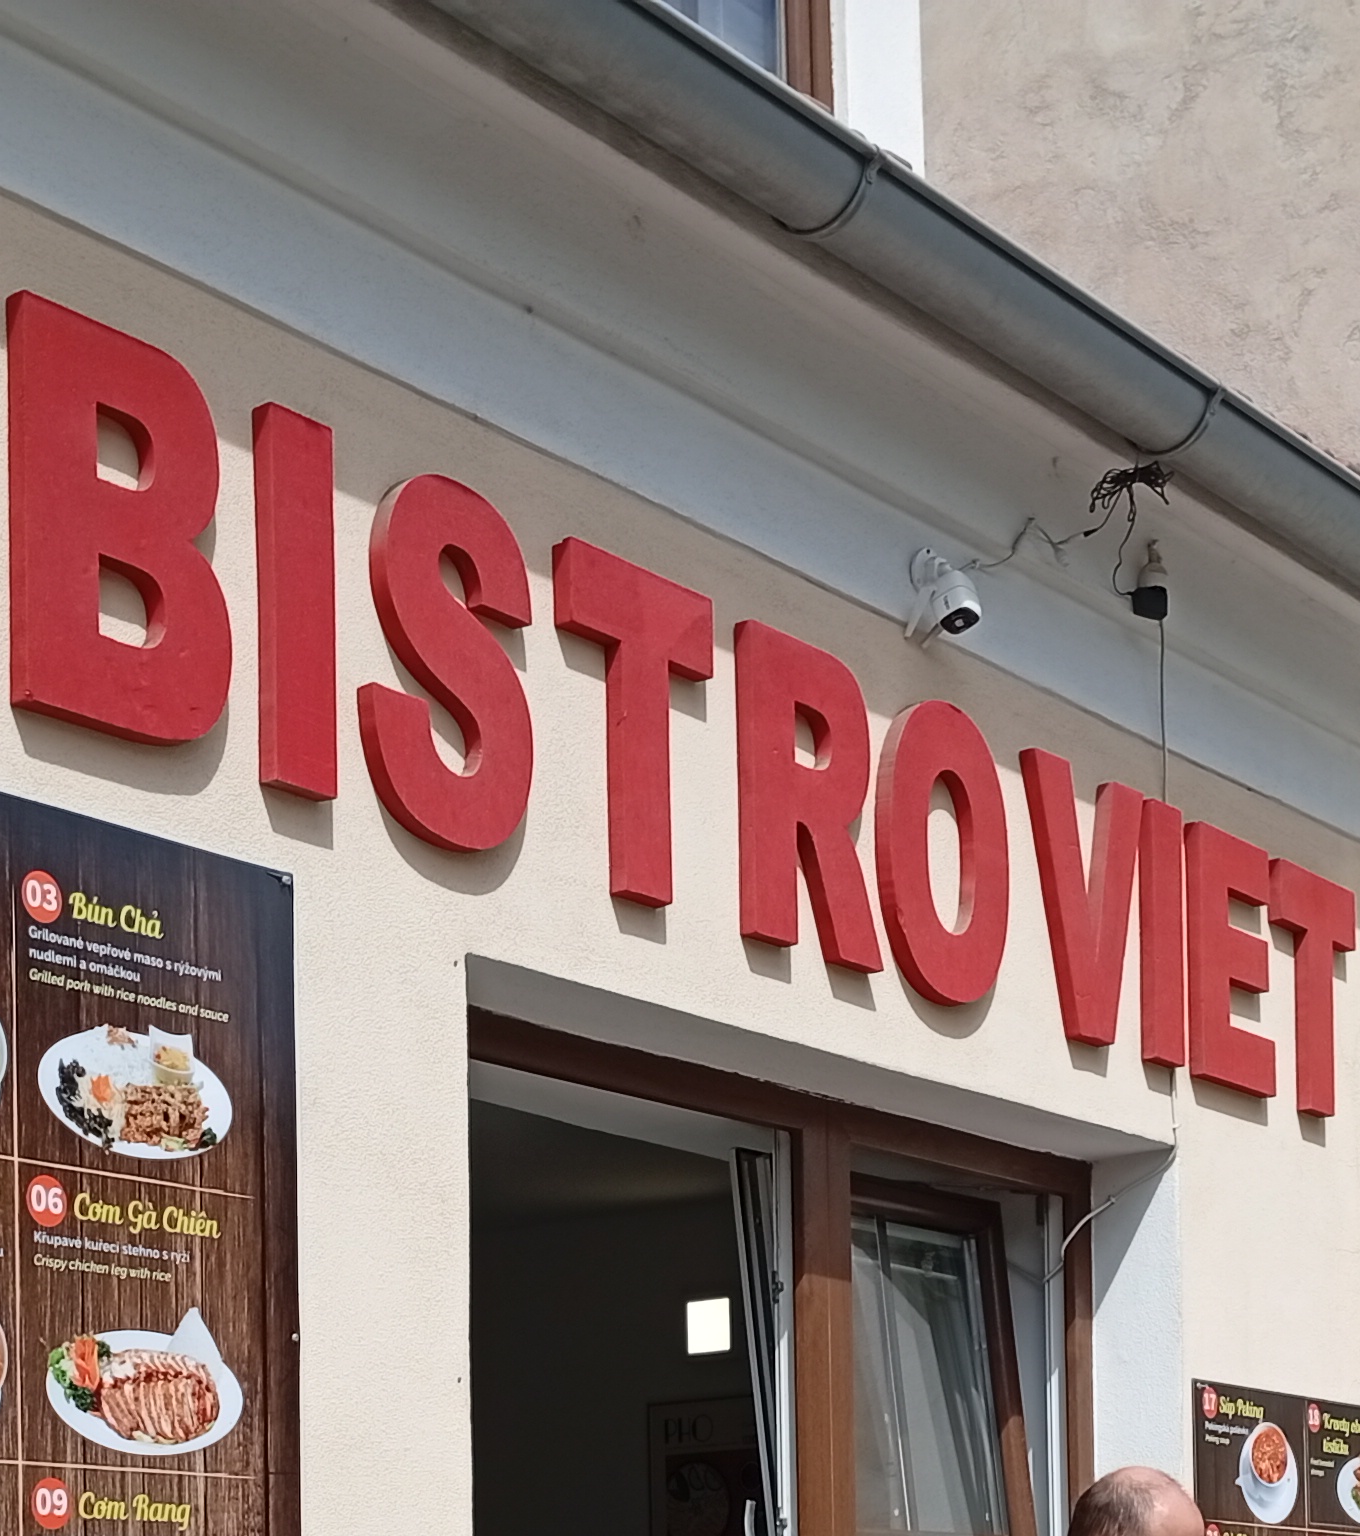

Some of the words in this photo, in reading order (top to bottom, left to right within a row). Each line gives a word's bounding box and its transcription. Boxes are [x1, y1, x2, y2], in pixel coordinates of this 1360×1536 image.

[8, 290, 1010, 1008] BISTRO
[1020, 746, 1357, 1120] VIET
[26, 880, 58, 911] 03
[69, 892, 116, 928] Bún
[31, 1184, 63, 1215] 06
[128, 1200, 159, 1234] Gà
[163, 1206, 221, 1239] Chiên
[1203, 1393, 1216, 1411] 17
[36, 1488, 68, 1516] 09
[132, 1494, 190, 1531] Rang
